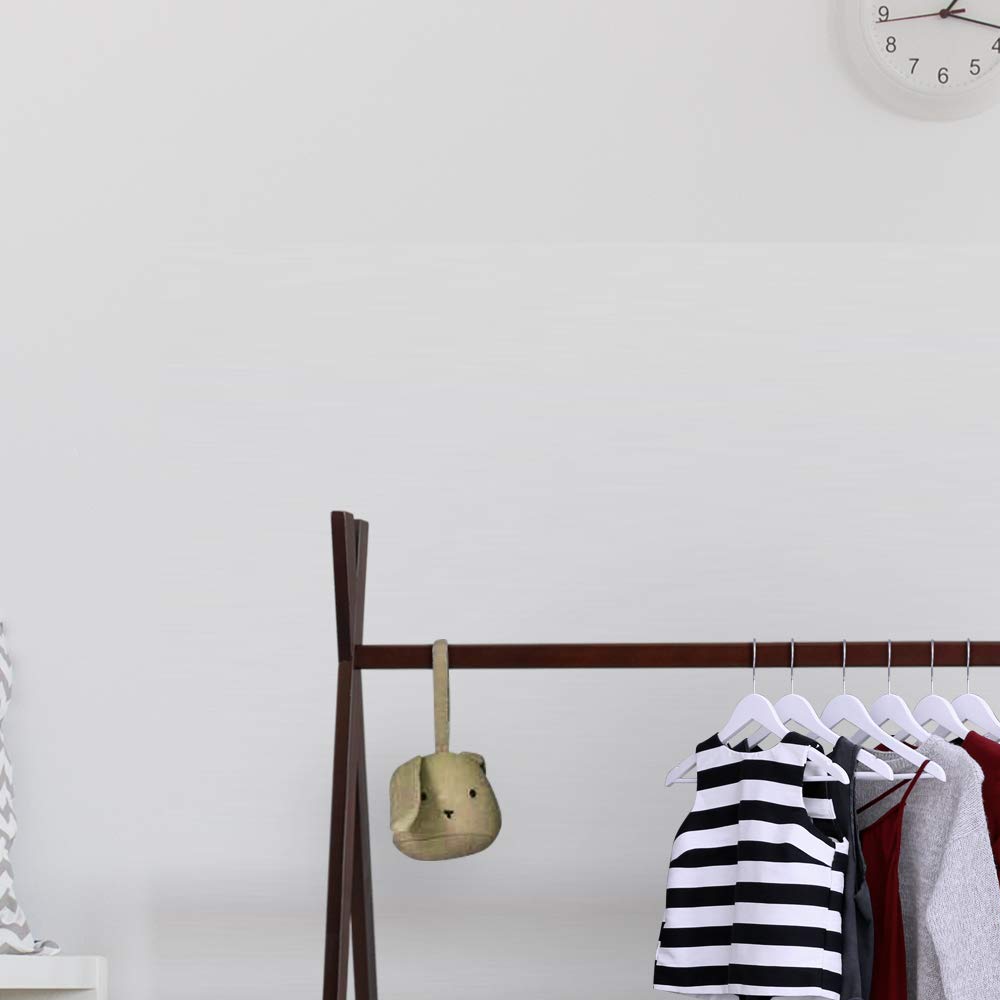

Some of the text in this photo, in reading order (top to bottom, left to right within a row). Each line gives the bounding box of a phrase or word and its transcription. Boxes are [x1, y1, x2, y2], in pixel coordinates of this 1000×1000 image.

[878, 5, 889, 22] 9
[885, 36, 897, 53] 8
[908, 58, 920, 74] 7
[969, 59, 981, 75] 5
[937, 67, 949, 84] 6
